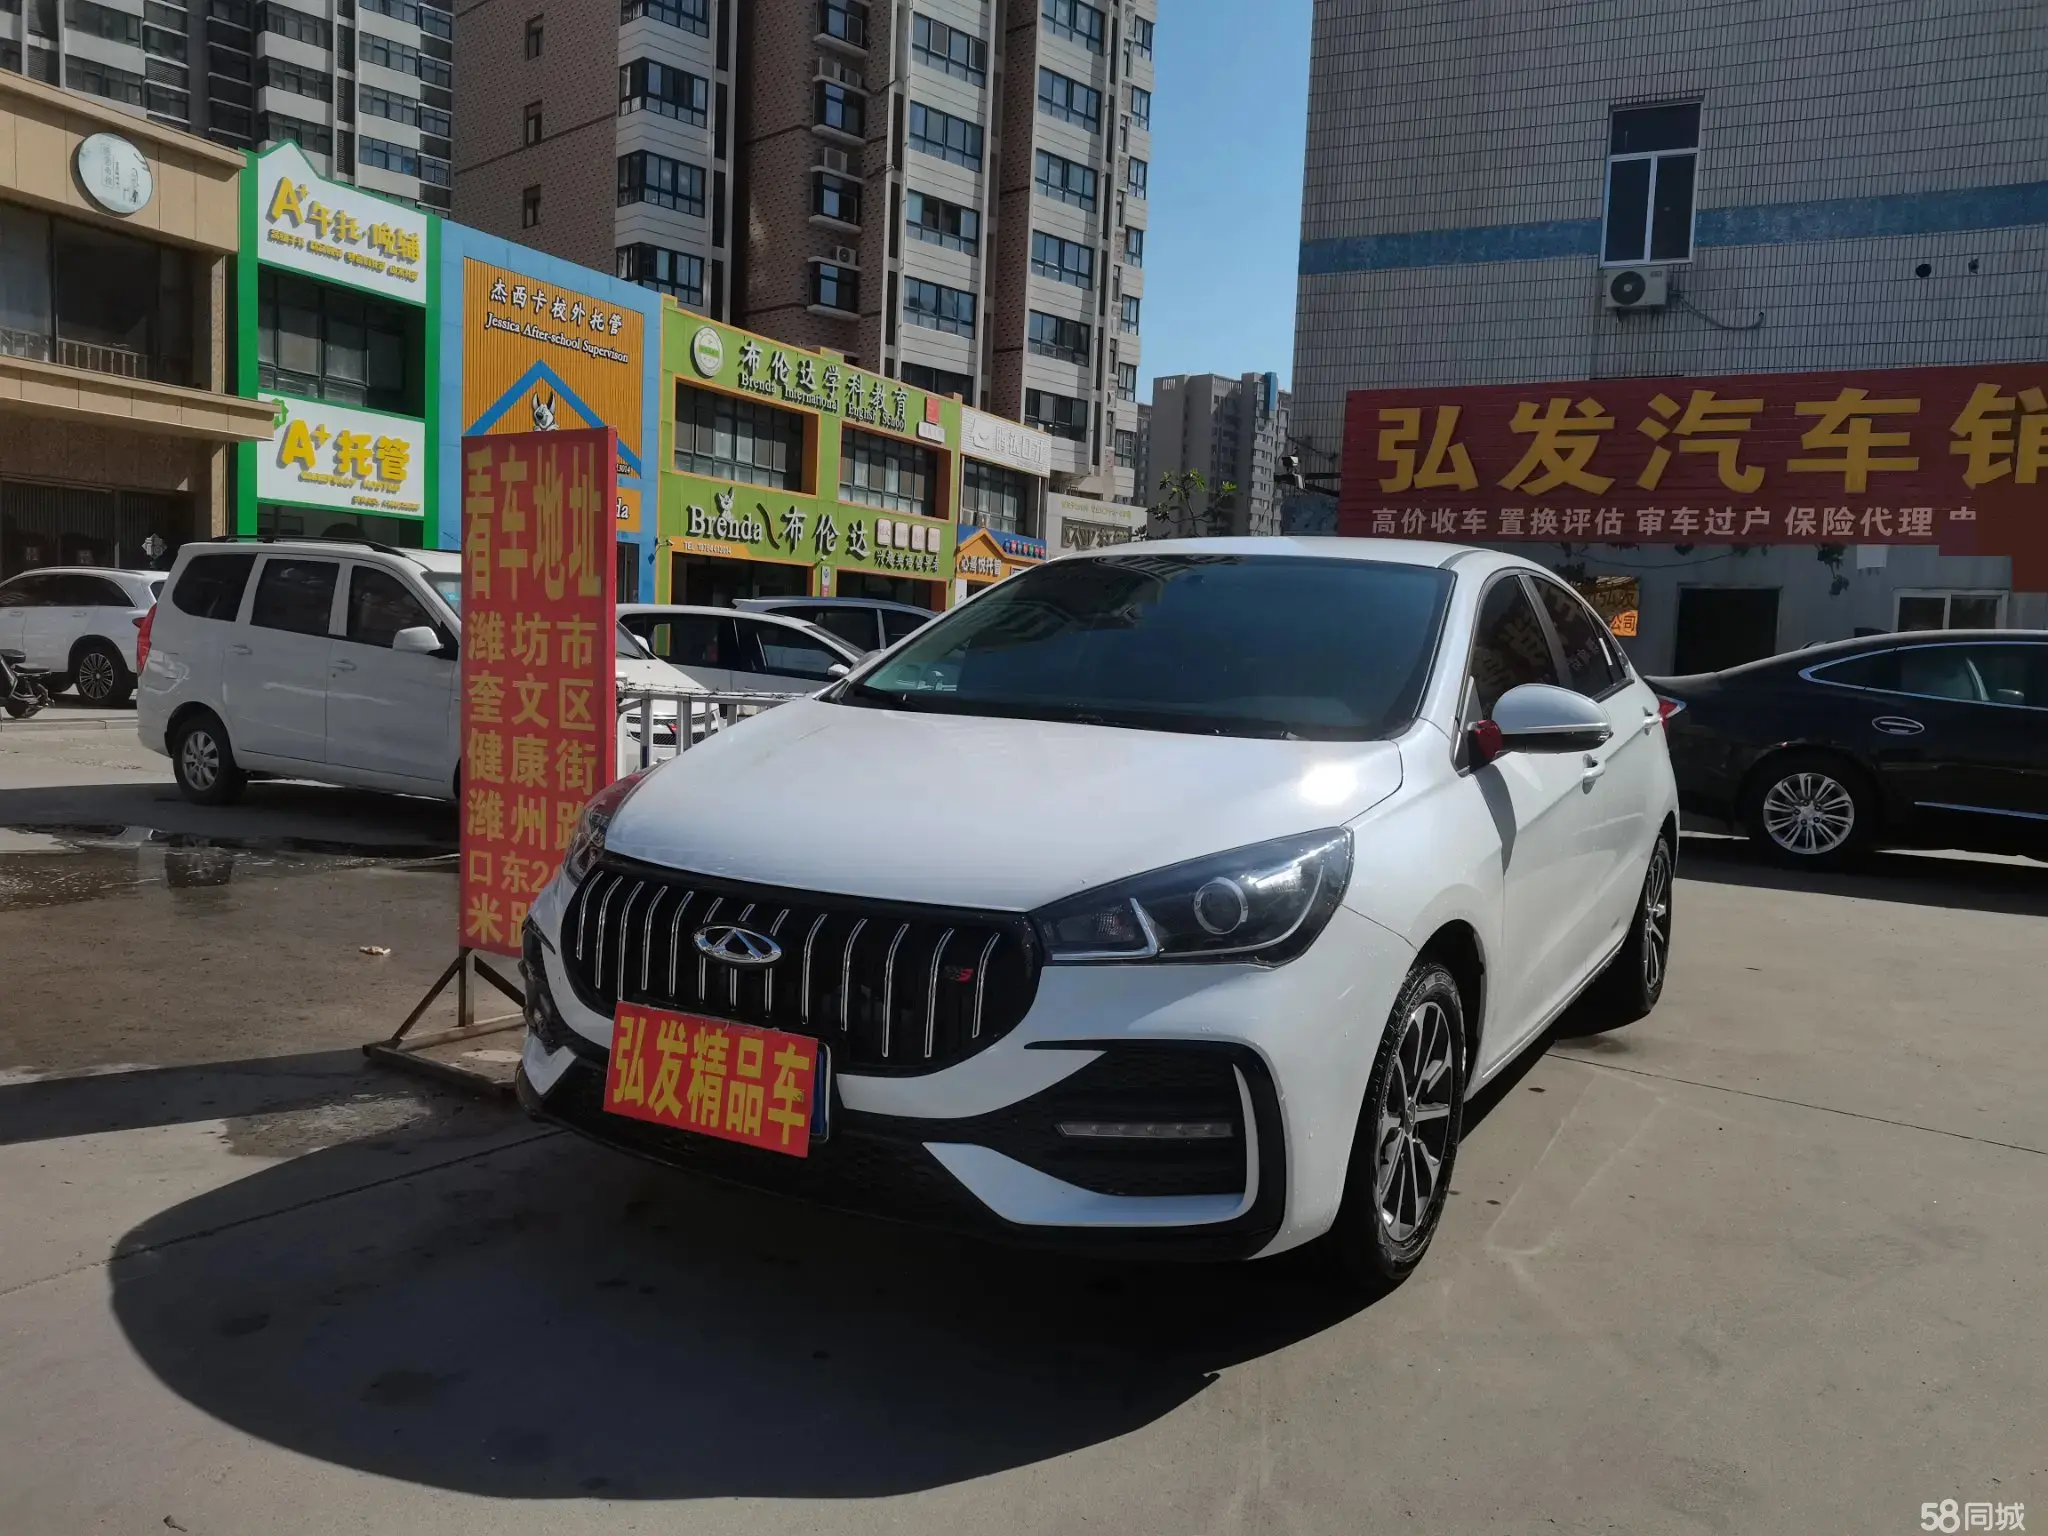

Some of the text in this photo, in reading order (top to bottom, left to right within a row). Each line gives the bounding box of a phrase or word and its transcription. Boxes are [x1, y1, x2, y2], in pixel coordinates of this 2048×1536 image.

[490, 277, 622, 335] 杰西卡校外托管
[485, 312, 629, 364] Jessica After-school Supervison
[741, 371, 777, 394] Brenda
[784, 384, 840, 412] International
[742, 340, 909, 418] 布伦达学科教育
[337, 429, 411, 481] 托管
[1378, 382, 2048, 496] 弘发汽车销
[465, 442, 602, 601] 看车地址
[688, 504, 763, 542] Brenda
[782, 504, 871, 558] 布伦达
[1371, 507, 1488, 535] 高价收车
[1497, 507, 1625, 536] 置换评估
[1637, 506, 1770, 537] 审车过户
[1784, 506, 1933, 537] 保险代理
[468, 610, 598, 669] 潍坊市
[1610, 614, 1636, 632] 公司
[467, 669, 597, 731] 奎文区
[466, 727, 598, 796] 健康街
[468, 850, 558, 894] 口东2
[612, 1016, 811, 1146] 弘发精品车
